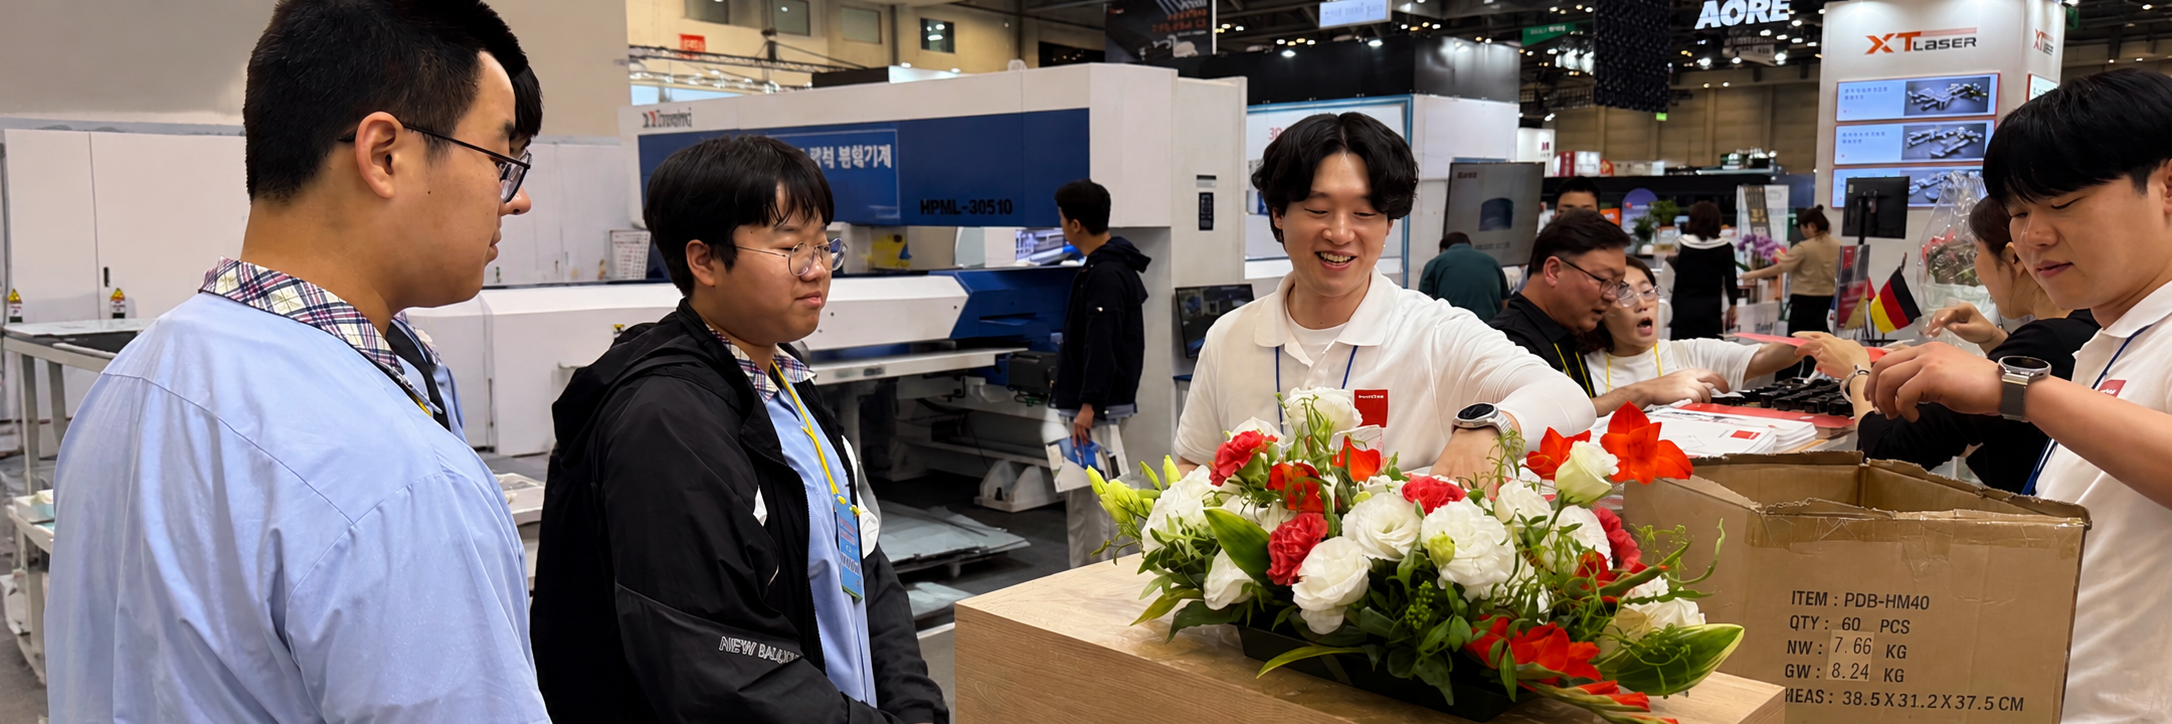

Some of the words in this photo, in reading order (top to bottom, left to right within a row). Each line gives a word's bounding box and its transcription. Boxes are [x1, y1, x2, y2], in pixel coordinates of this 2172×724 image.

[1694, 0, 1790, 29] AORE
[920, 199, 1013, 215] HPML-30510
[1791, 590, 1828, 606] ITEM
[1844, 592, 1930, 610] PDB-HM40
[1789, 615, 1820, 631] QTY
[1841, 617, 1861, 631] 60
[1879, 619, 1911, 634] PCS
[719, 636, 757, 656] NEW
[1786, 640, 1813, 655] NW
[1834, 636, 1873, 655] 7.66
[1885, 644, 1907, 659] KG
[1784, 664, 1811, 679] GW
[1831, 662, 1870, 680] 8.24
[1883, 668, 1905, 683] KG
